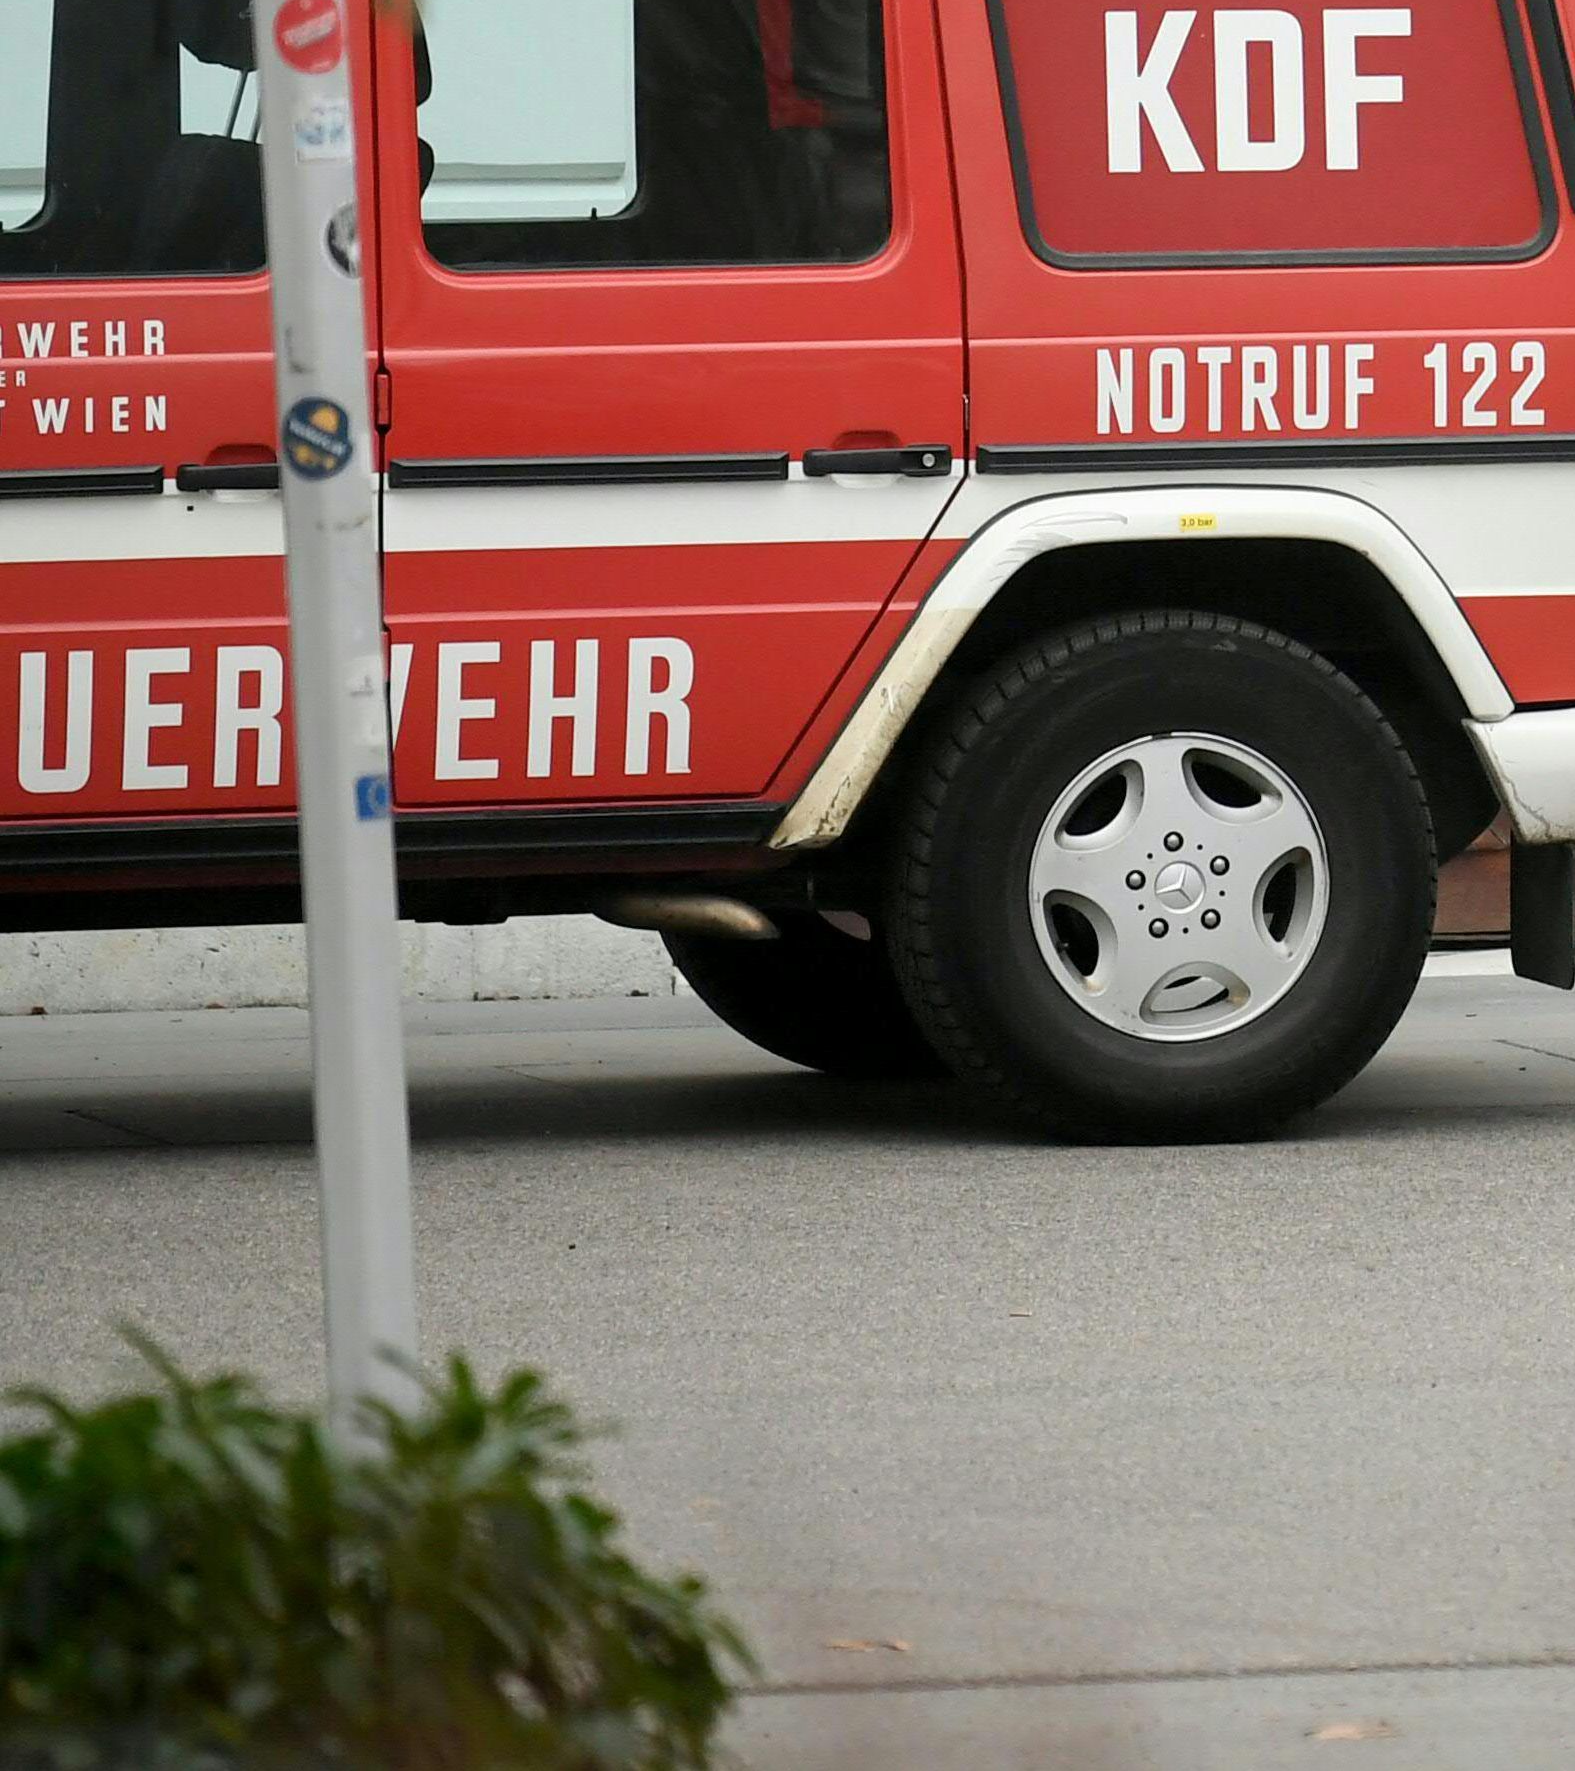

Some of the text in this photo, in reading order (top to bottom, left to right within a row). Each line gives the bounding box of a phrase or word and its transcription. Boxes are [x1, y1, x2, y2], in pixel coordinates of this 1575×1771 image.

[1104, 8, 1412, 174] KDF
[0, 320, 165, 359] WEHR
[31, 395, 166, 435] WIEN
[1096, 340, 1546, 435] NOTRUF 122
[17, 635, 694, 795] UEREHR
